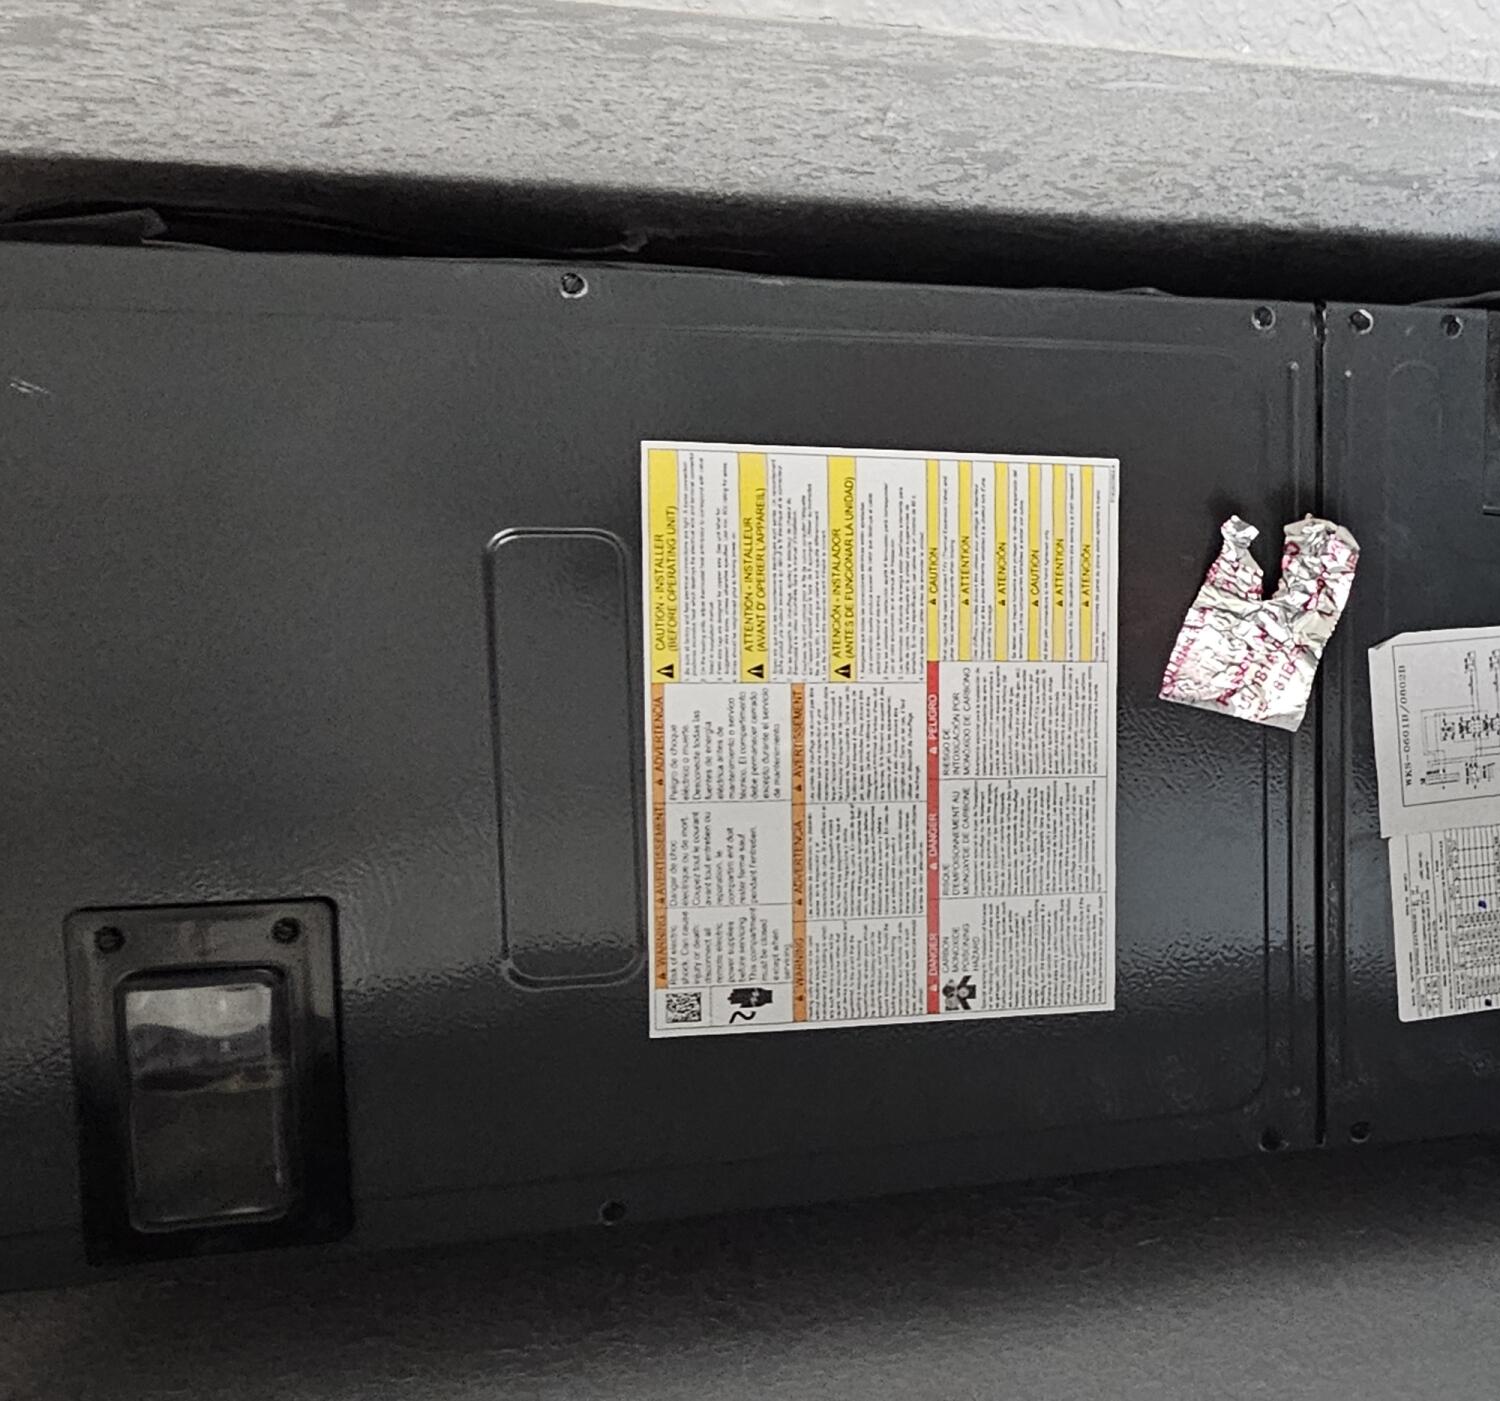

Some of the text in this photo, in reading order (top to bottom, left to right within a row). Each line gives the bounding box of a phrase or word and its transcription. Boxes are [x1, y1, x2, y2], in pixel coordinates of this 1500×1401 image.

[755, 488, 766, 551] L'APPAREIL)
[654, 534, 664, 593] INSTALLER
[743, 517, 753, 583] INSTALLEUR
[832, 528, 841, 595] INSTALADOR
[844, 477, 855, 658] (ANTES DE FUNCIONAR LA UNIDAD)
[929, 547, 938, 594] CAUTION
[961, 535, 970, 594] ATTENTION
[996, 542, 1006, 595] ATENCIÓN
[1031, 549, 1039, 595] CAUTION
[1055, 538, 1064, 596] ATTENTION
[1081, 544, 1091, 596] ATENCIÓN
[665, 505, 677, 651] (BEFORE OPERATING UNIT)
[756, 553, 765, 598] OPERER
[655, 602, 664, 651] CAUTION
[744, 592, 754, 652] ATTENTION
[756, 614, 767, 652] (AVANT
[830, 604, 841, 659] ATENCIÓN
[653, 696, 663, 772] ADVERTENCIA
[670, 724, 679, 755] choque
[793, 690, 802, 777] AVERTISSEMENT
[928, 694, 937, 740] PELIGRO
[943, 729, 950, 740] DE
[963, 715, 970, 726] DE
[669, 771, 679, 800] Peligro
[952, 791, 960, 803] AU
[929, 813, 937, 856] DANGER
[962, 833, 969, 843] DE
[929, 933, 937, 976] DANGER
